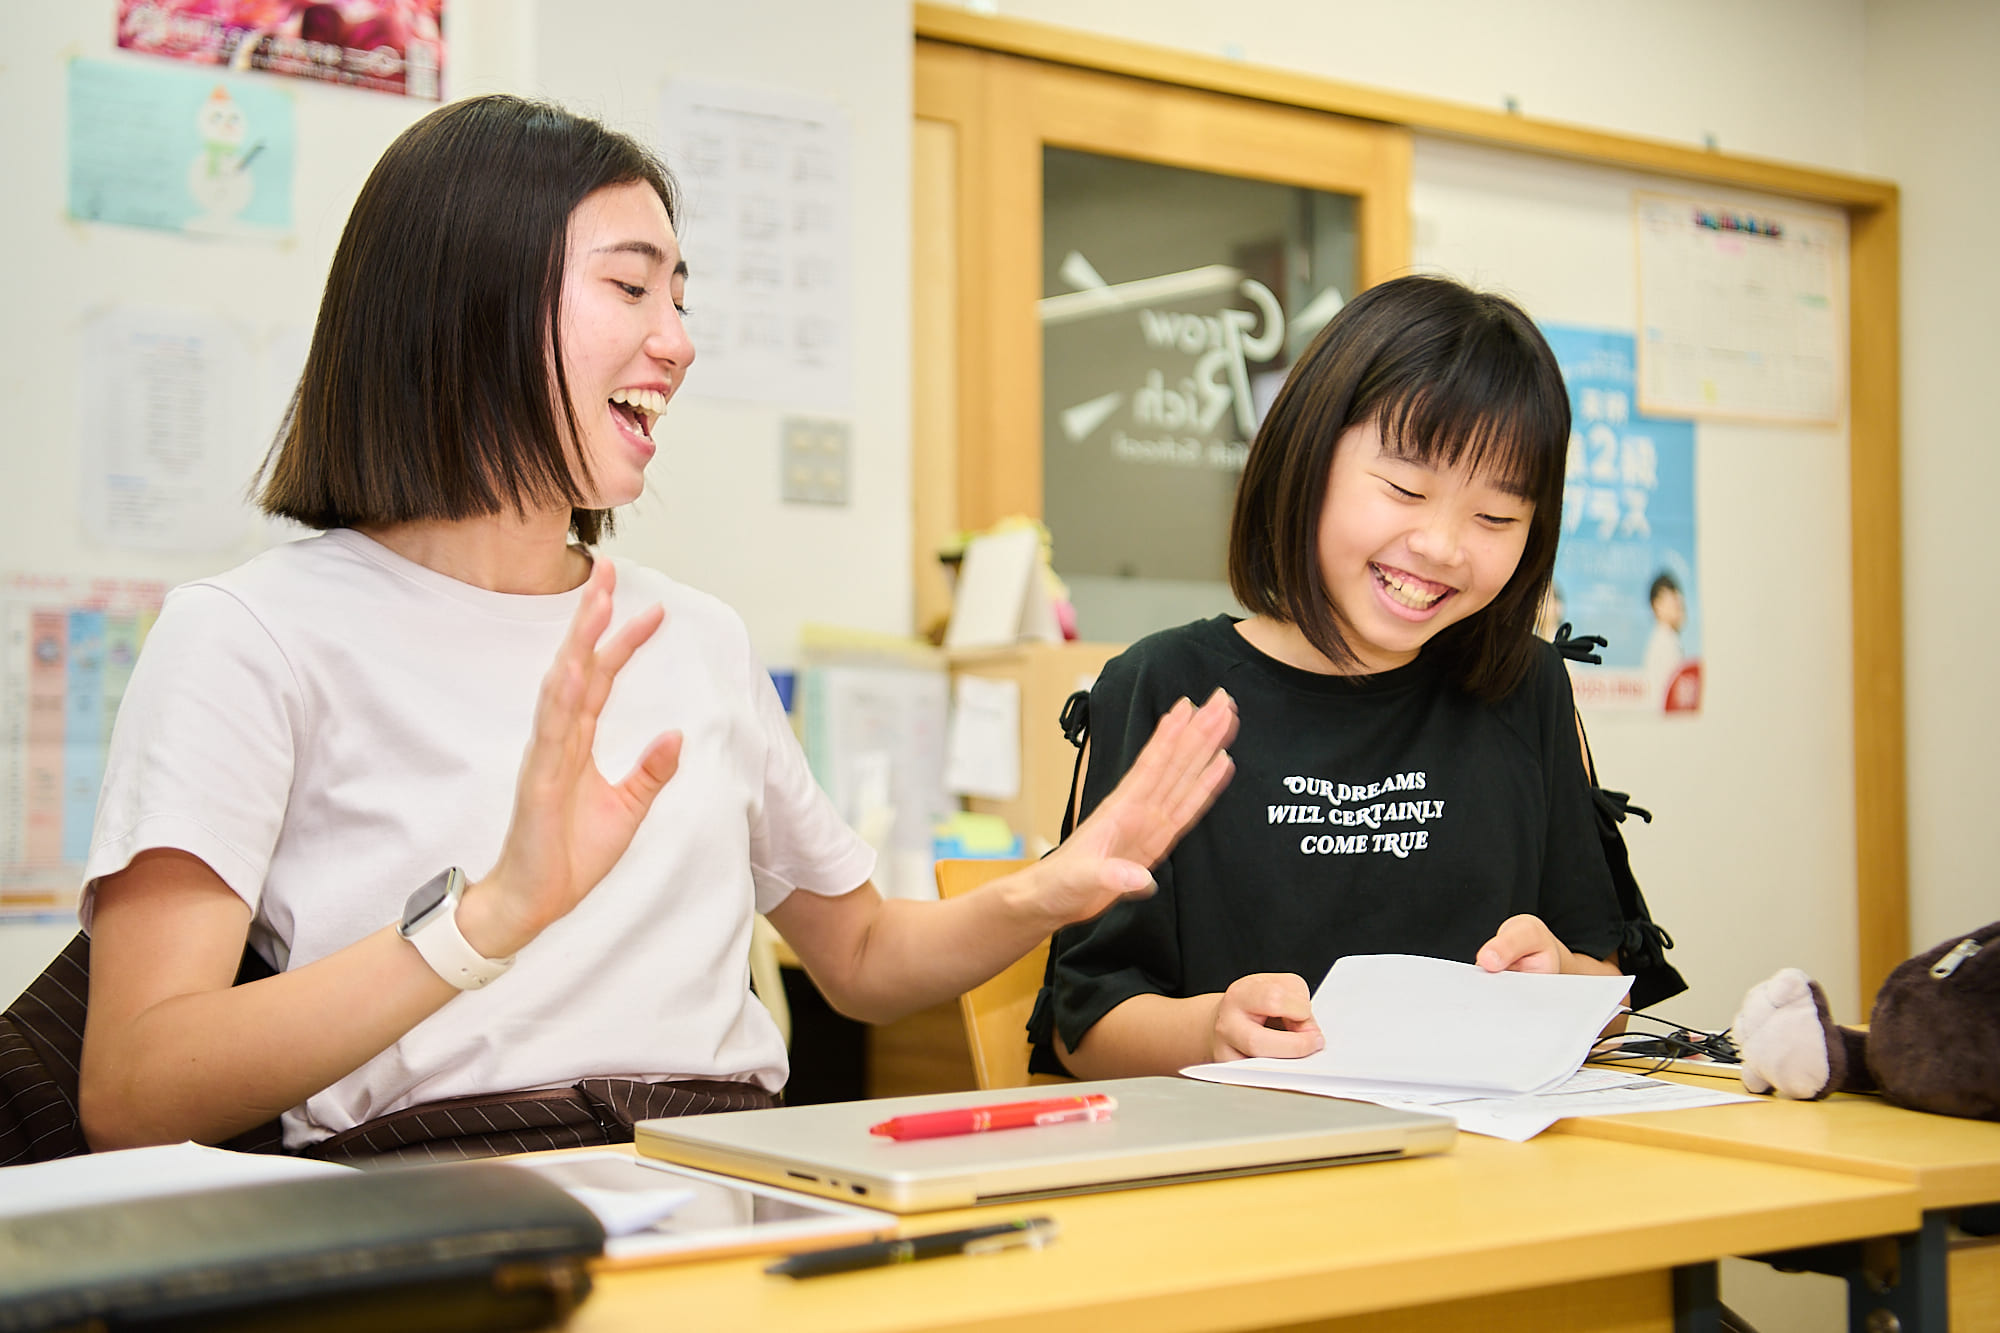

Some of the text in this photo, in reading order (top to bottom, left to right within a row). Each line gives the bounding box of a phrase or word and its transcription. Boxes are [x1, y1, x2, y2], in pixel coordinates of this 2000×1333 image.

[1283, 772, 1426, 806] OUR DREAMS
[1267, 800, 1445, 829] WILL CERTAINLY
[1300, 831, 1429, 859] COME TRUE
